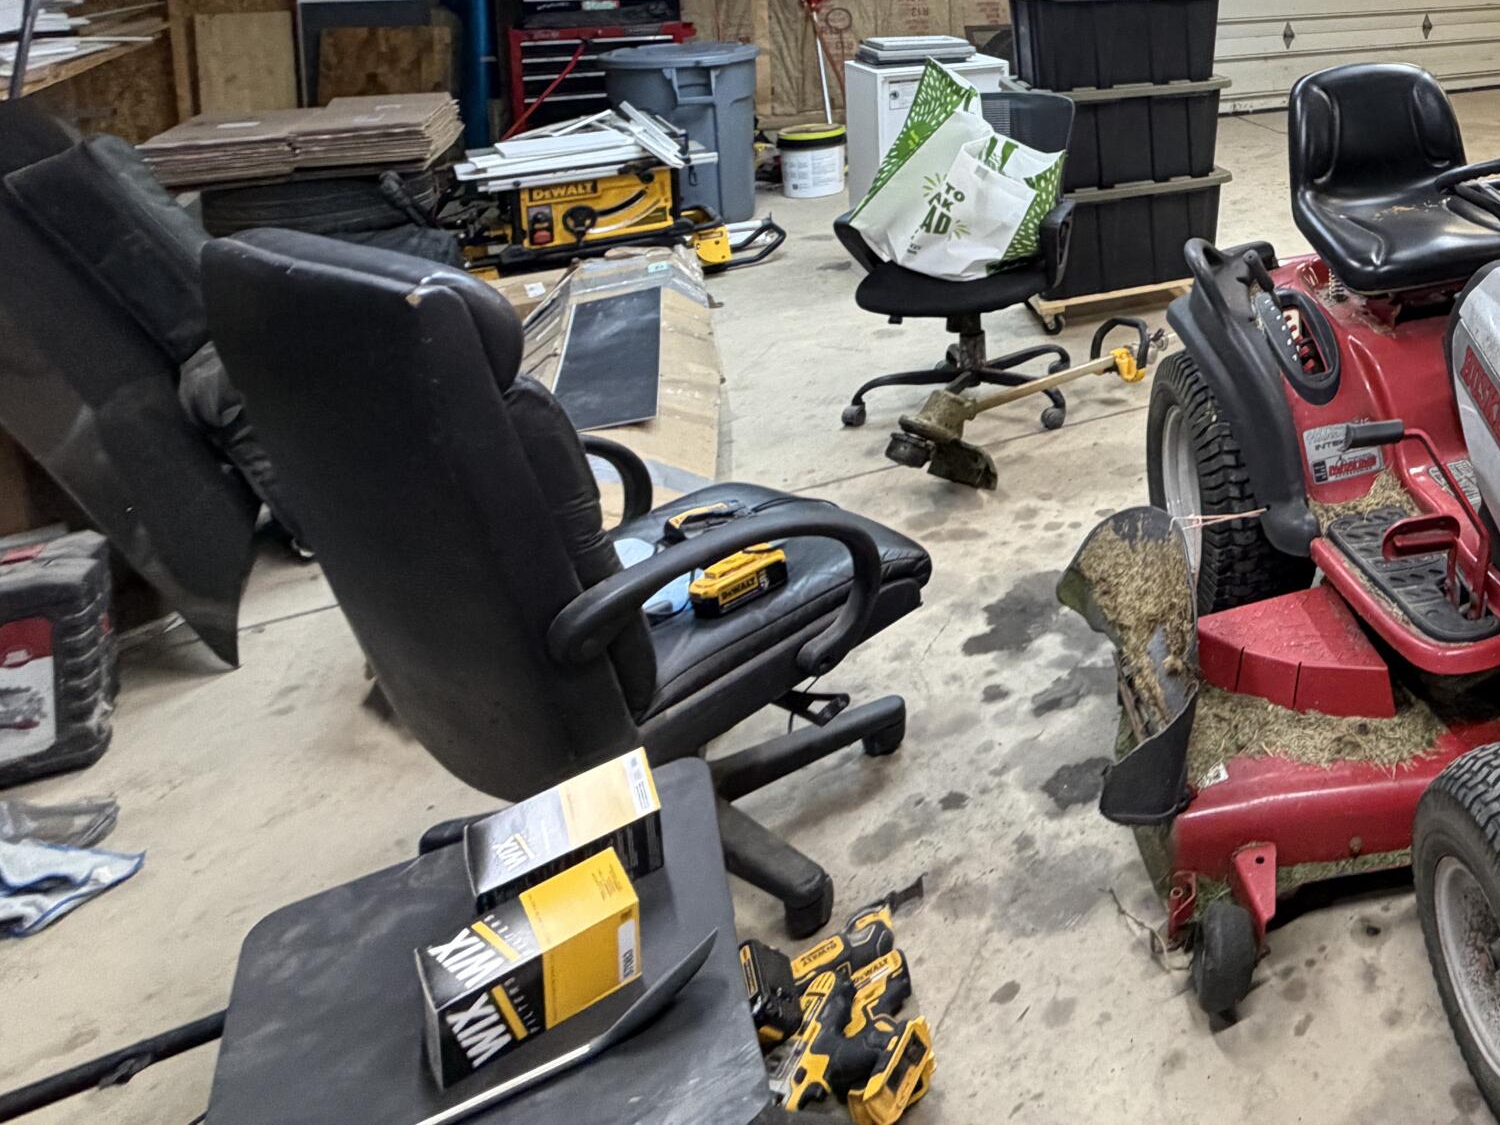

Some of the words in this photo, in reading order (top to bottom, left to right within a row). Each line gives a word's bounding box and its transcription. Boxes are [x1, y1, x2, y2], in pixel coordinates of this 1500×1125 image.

[492, 834, 530, 872] WIX
[426, 927, 504, 990] WIX
[446, 991, 513, 1069] WIX
[504, 976, 541, 1035] FILTERS
